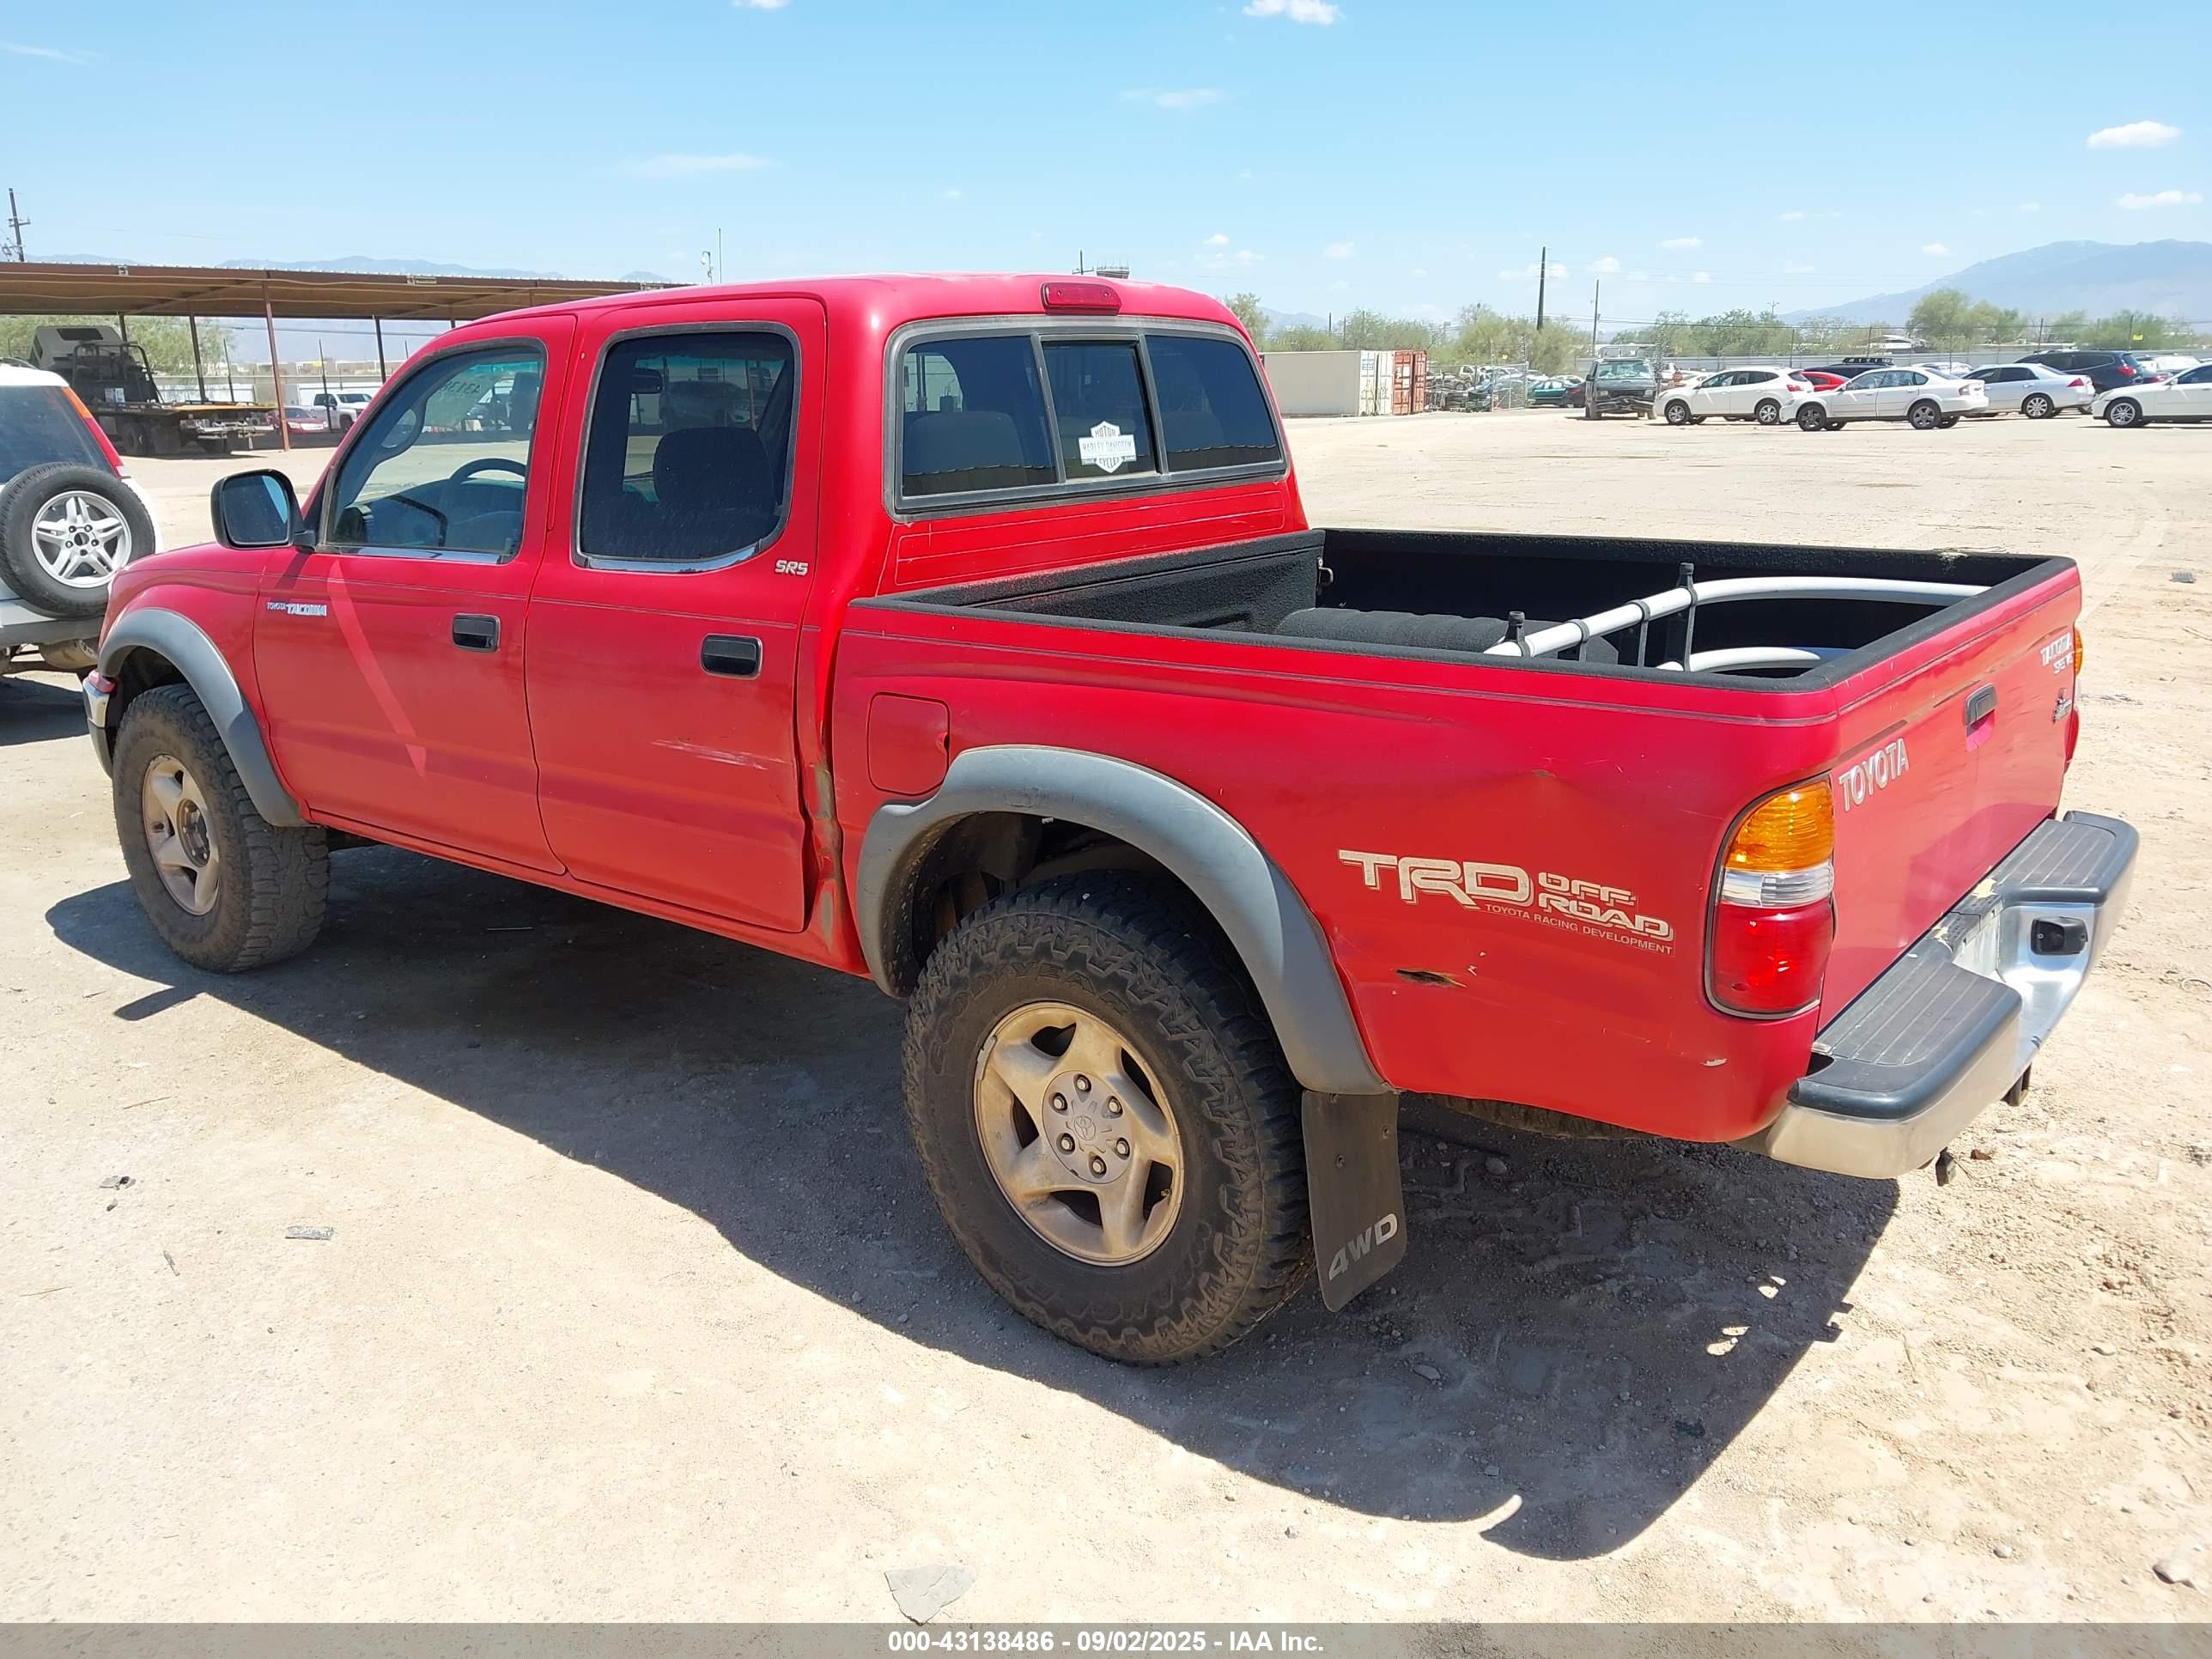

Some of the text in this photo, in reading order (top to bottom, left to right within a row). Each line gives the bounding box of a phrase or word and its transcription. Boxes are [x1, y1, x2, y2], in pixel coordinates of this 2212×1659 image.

[775, 559, 809, 576] SR5
[266, 601, 287, 611] TOYOTA
[1838, 738, 1911, 812] TOYOTA
[1338, 848, 1535, 910] TRD
[1538, 871, 1637, 906] OFF
[1485, 903, 1674, 956] TOYOTA RACING DEVELOPMENT
[1538, 891, 1675, 942] ROAD
[1328, 1212, 1399, 1282] 4WD
